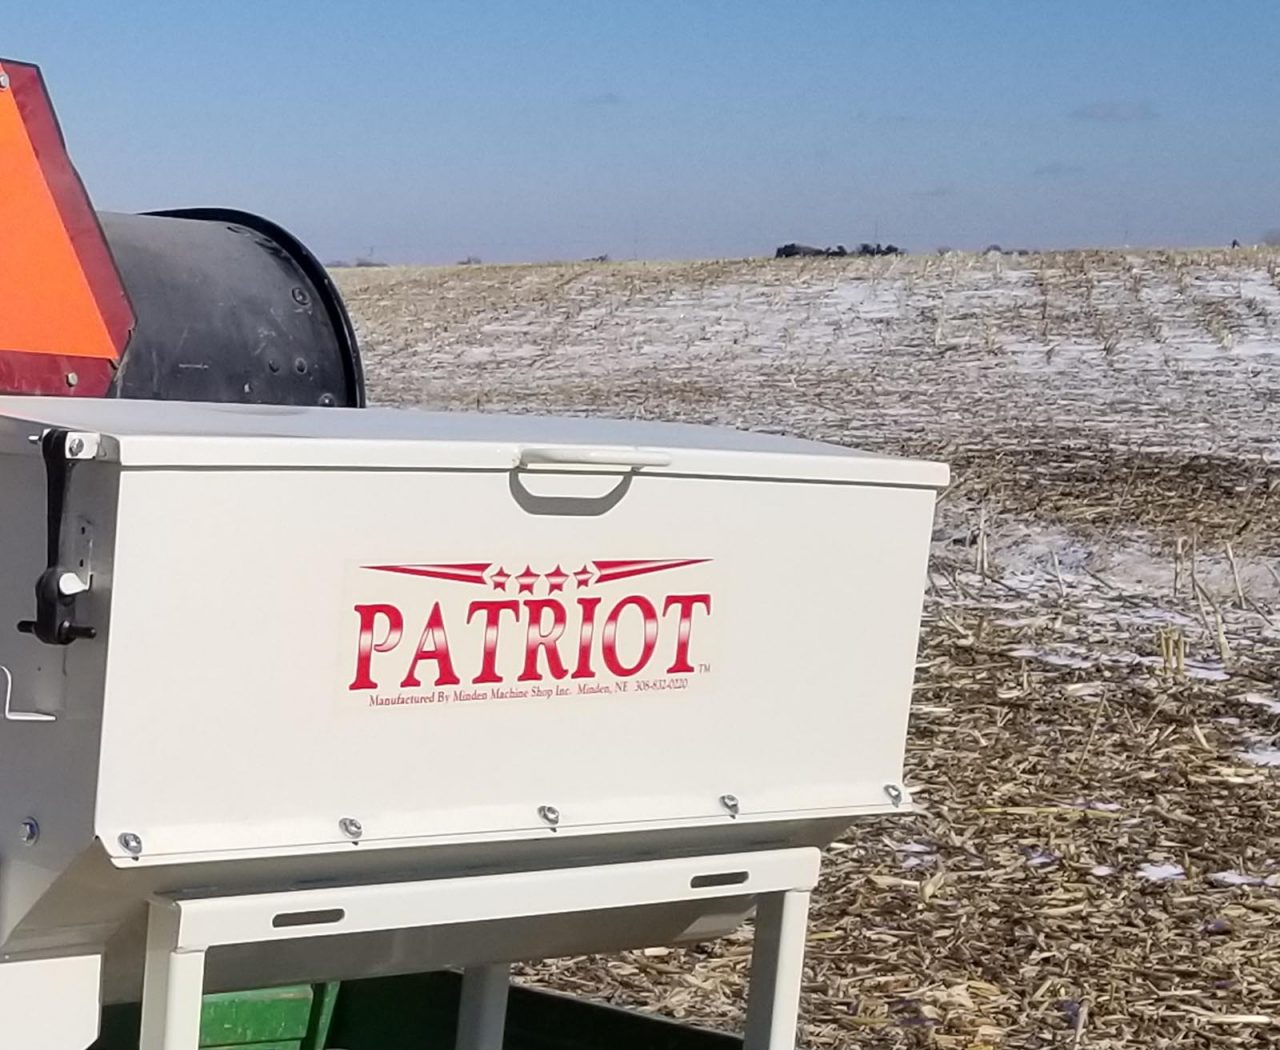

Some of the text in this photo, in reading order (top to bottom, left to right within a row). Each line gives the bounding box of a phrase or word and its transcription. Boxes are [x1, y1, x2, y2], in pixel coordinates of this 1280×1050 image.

[348, 593, 712, 691] PATRIOT
[368, 691, 435, 707] Manufactured
[437, 691, 450, 705] By
[452, 689, 488, 702] Minden
[490, 687, 529, 700] Machine
[531, 685, 553, 699] Shop
